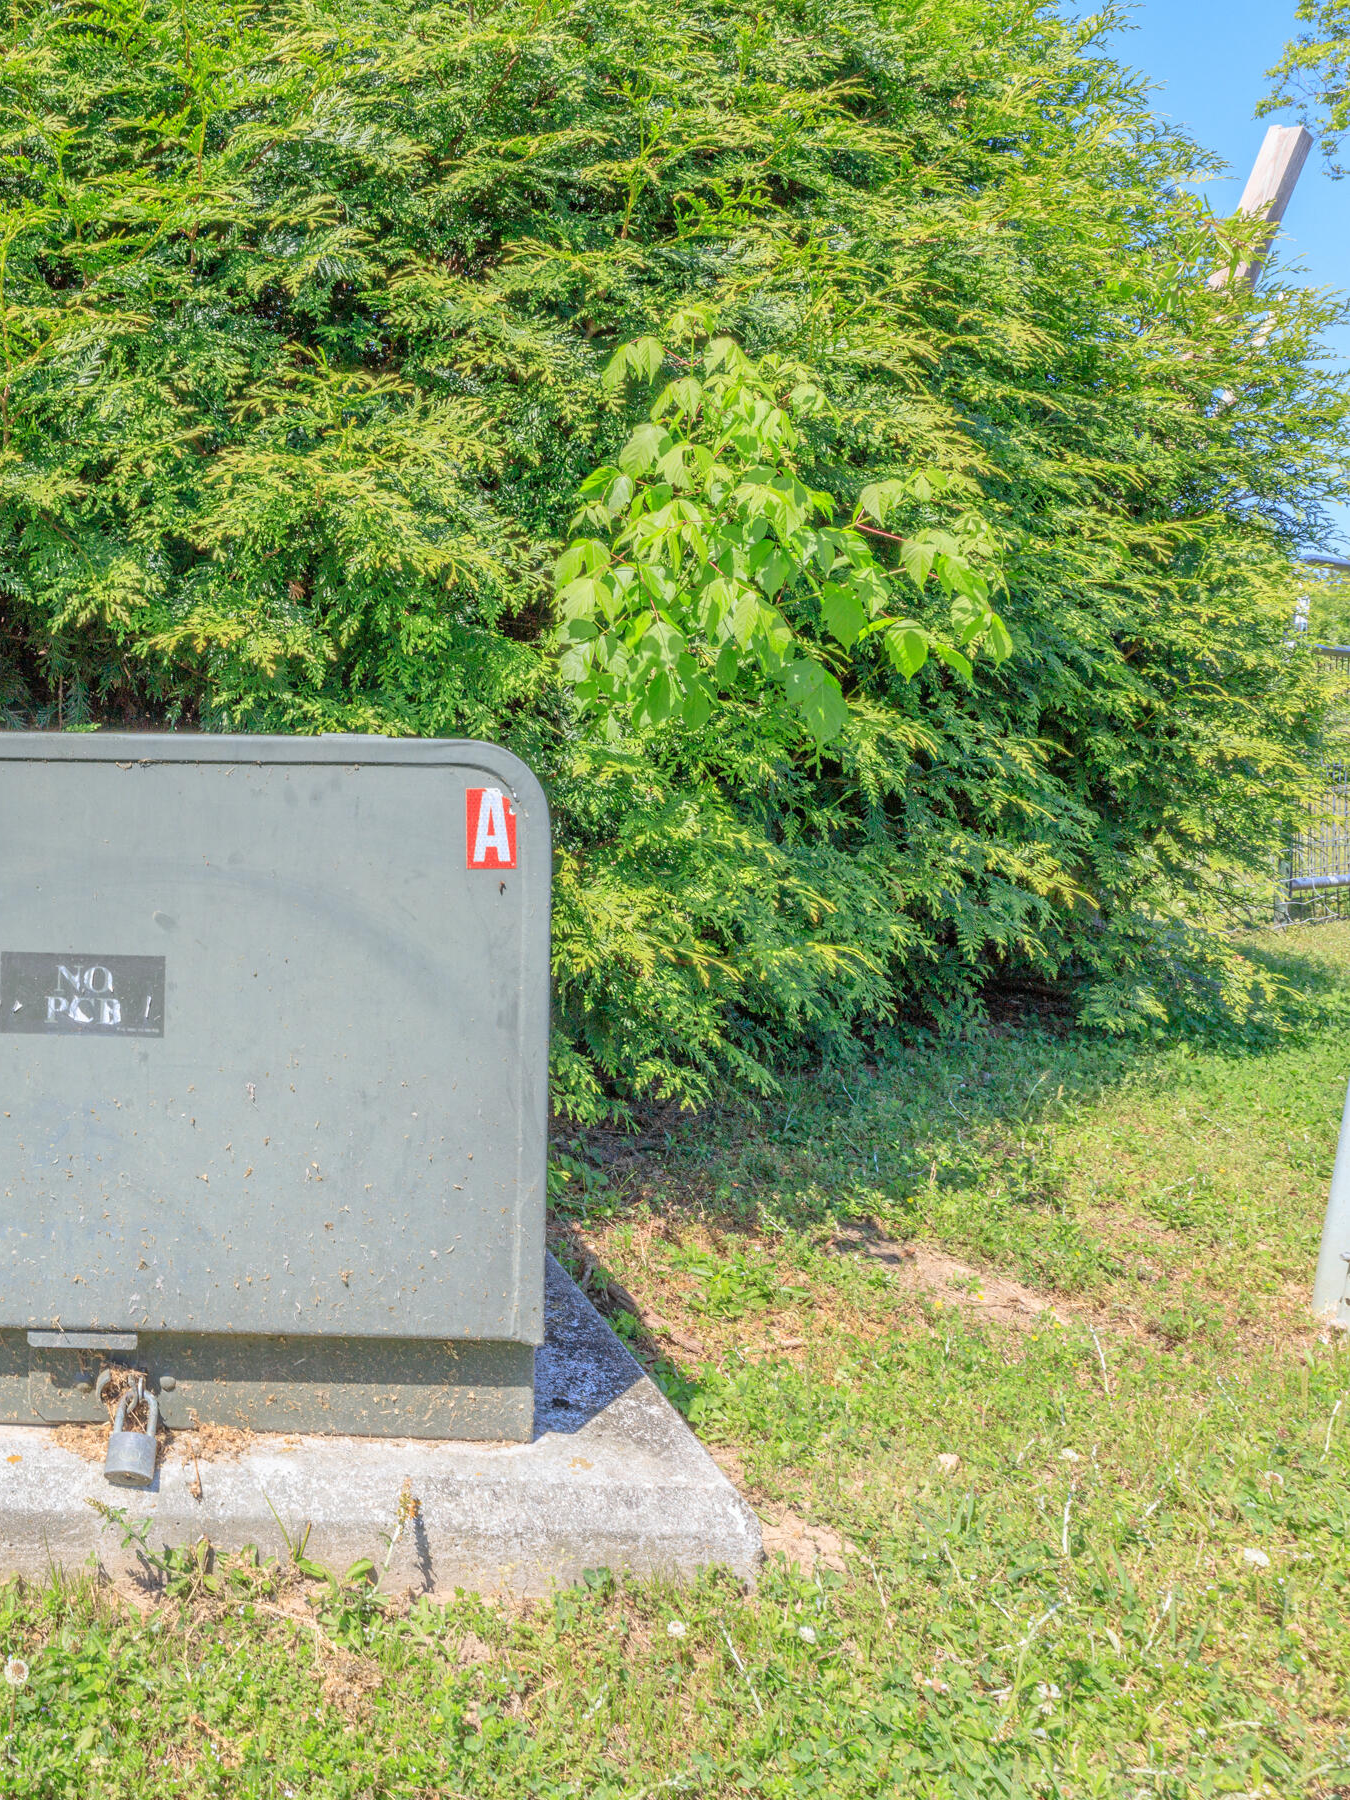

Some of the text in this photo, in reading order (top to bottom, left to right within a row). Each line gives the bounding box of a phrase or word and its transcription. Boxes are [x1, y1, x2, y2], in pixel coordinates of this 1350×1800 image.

[473, 788, 511, 862] A
[53, 964, 114, 993] NO
[43, 995, 122, 1025] PCB
